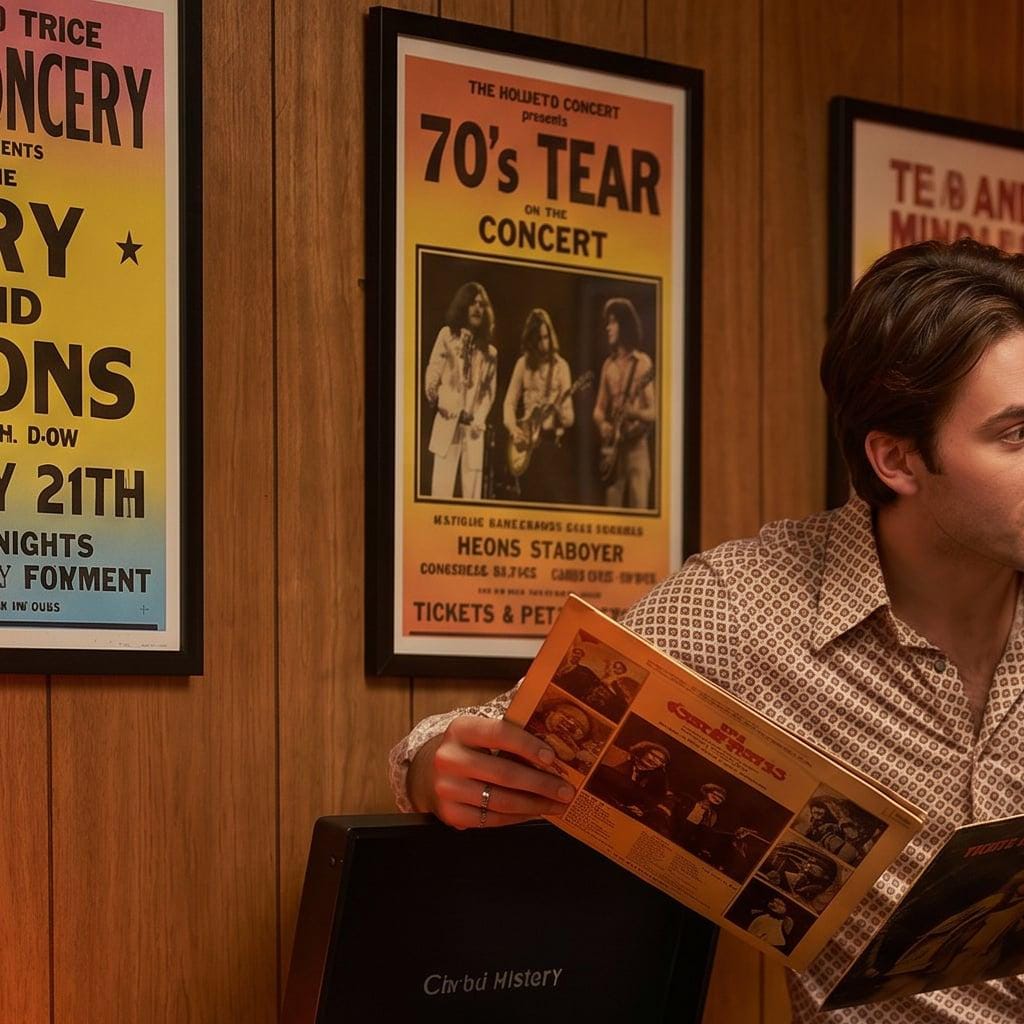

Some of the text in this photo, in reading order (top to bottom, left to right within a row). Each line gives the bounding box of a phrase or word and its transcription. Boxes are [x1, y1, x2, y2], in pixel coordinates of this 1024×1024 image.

[19, 8, 102, 49] TRICE
[0, 46, 152, 149] NCERY
[468, 80, 496, 98] THE
[563, 97, 621, 120] CONCERT
[522, 110, 568, 127] presents
[420, 113, 661, 217] 70's TEAR
[525, 204, 568, 220] ON THE
[478, 215, 608, 259] CONCERT
[37, 463, 145, 518] 21TH
[458, 535, 624, 564] HEONS STABOYER
[413, 601, 563, 625] TICKETS & PET
